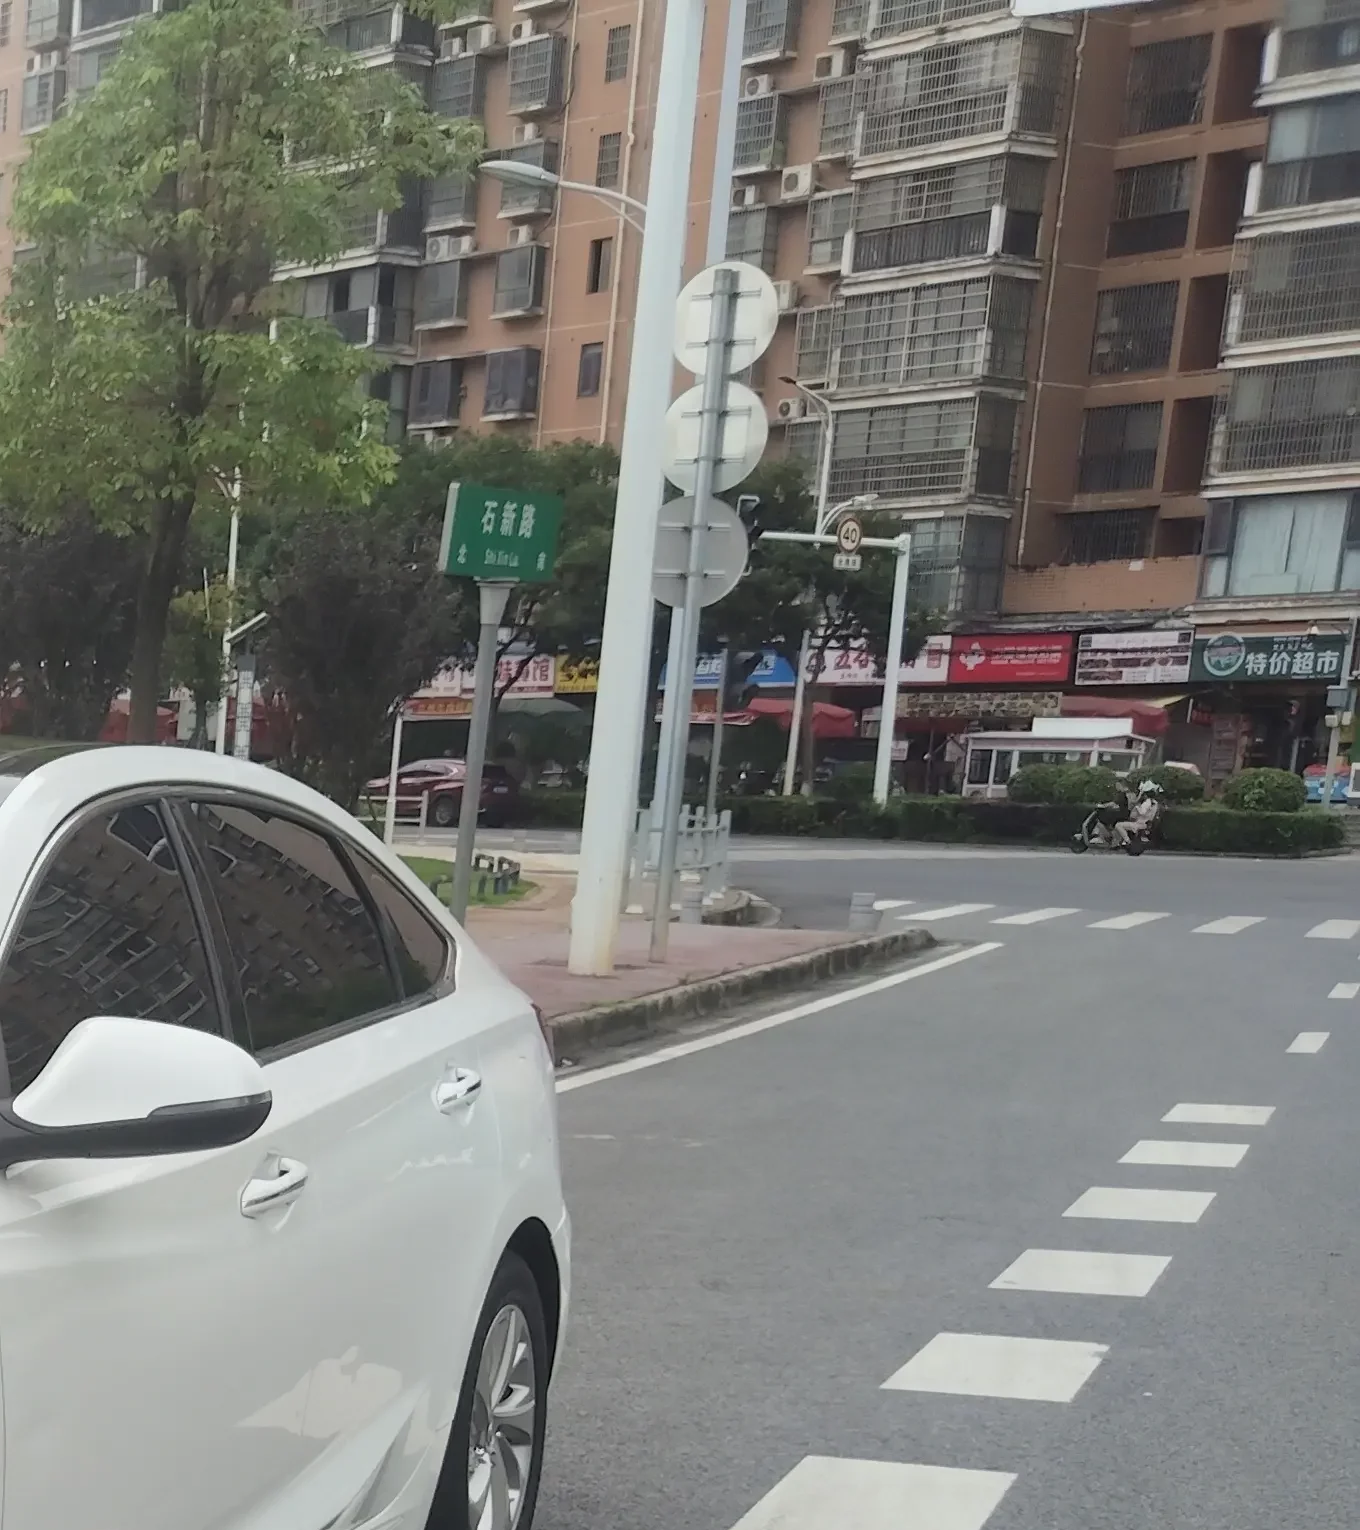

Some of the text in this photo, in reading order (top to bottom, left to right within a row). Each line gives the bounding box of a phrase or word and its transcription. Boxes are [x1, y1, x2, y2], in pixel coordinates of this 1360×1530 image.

[481, 500, 536, 539] 石新路
[842, 527, 857, 544] 40
[1245, 651, 1340, 676] 特价超市
